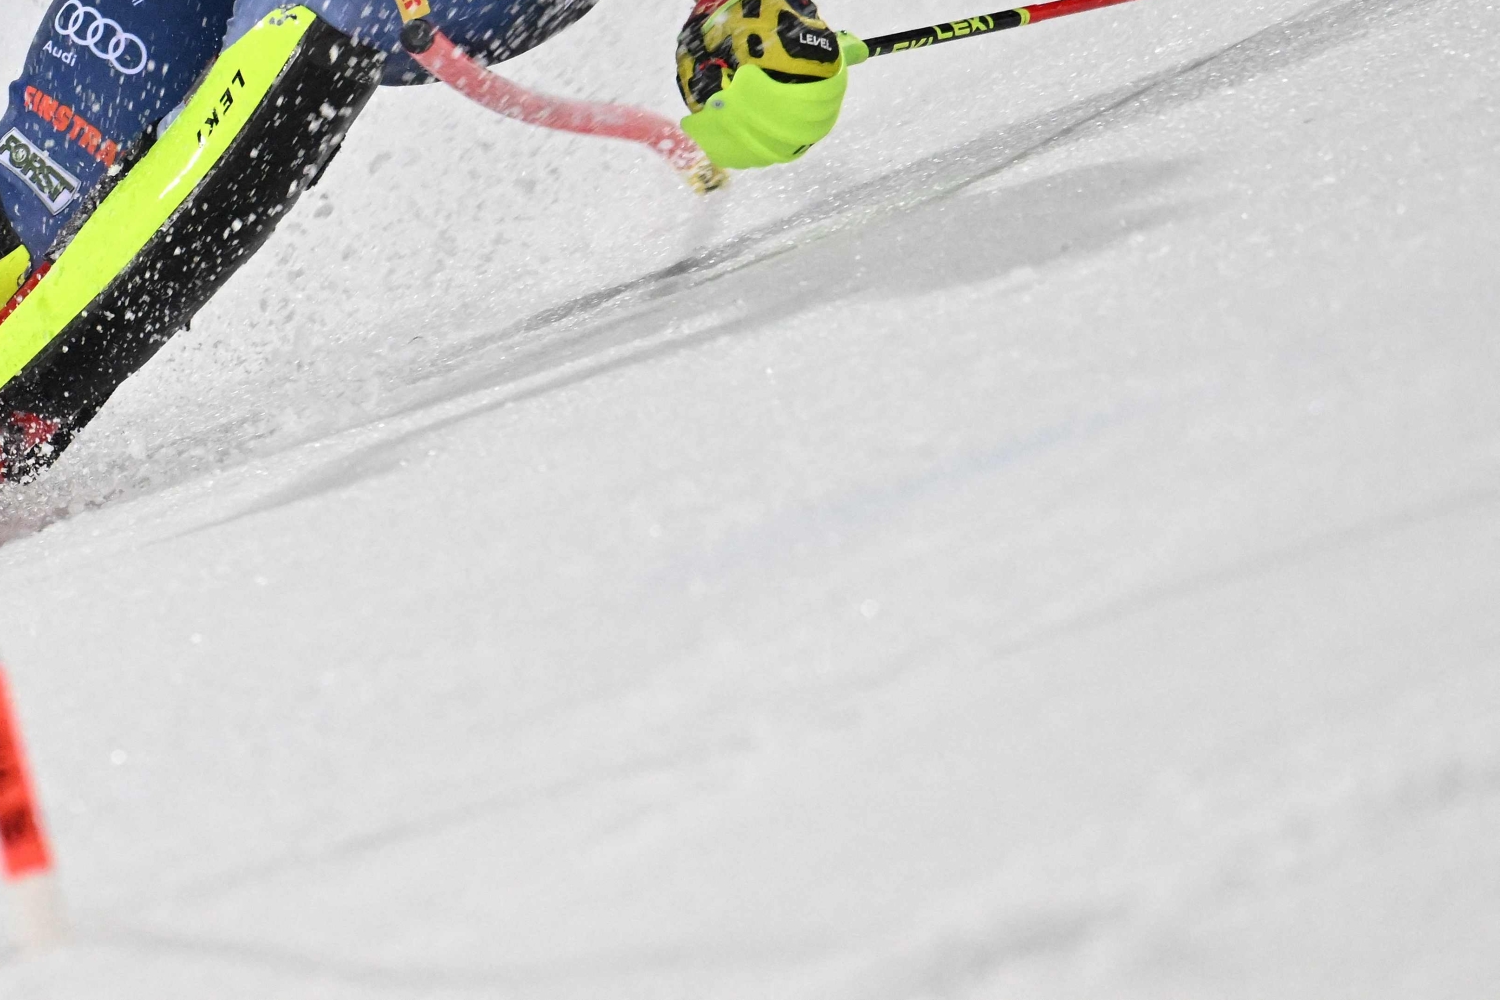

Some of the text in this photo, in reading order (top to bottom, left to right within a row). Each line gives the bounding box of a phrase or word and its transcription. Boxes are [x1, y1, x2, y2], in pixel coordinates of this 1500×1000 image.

[932, 13, 995, 41] LEKI
[42, 40, 78, 67] Audi
[799, 32, 832, 51] LEVEL
[23, 85, 126, 168] FINSTRA
